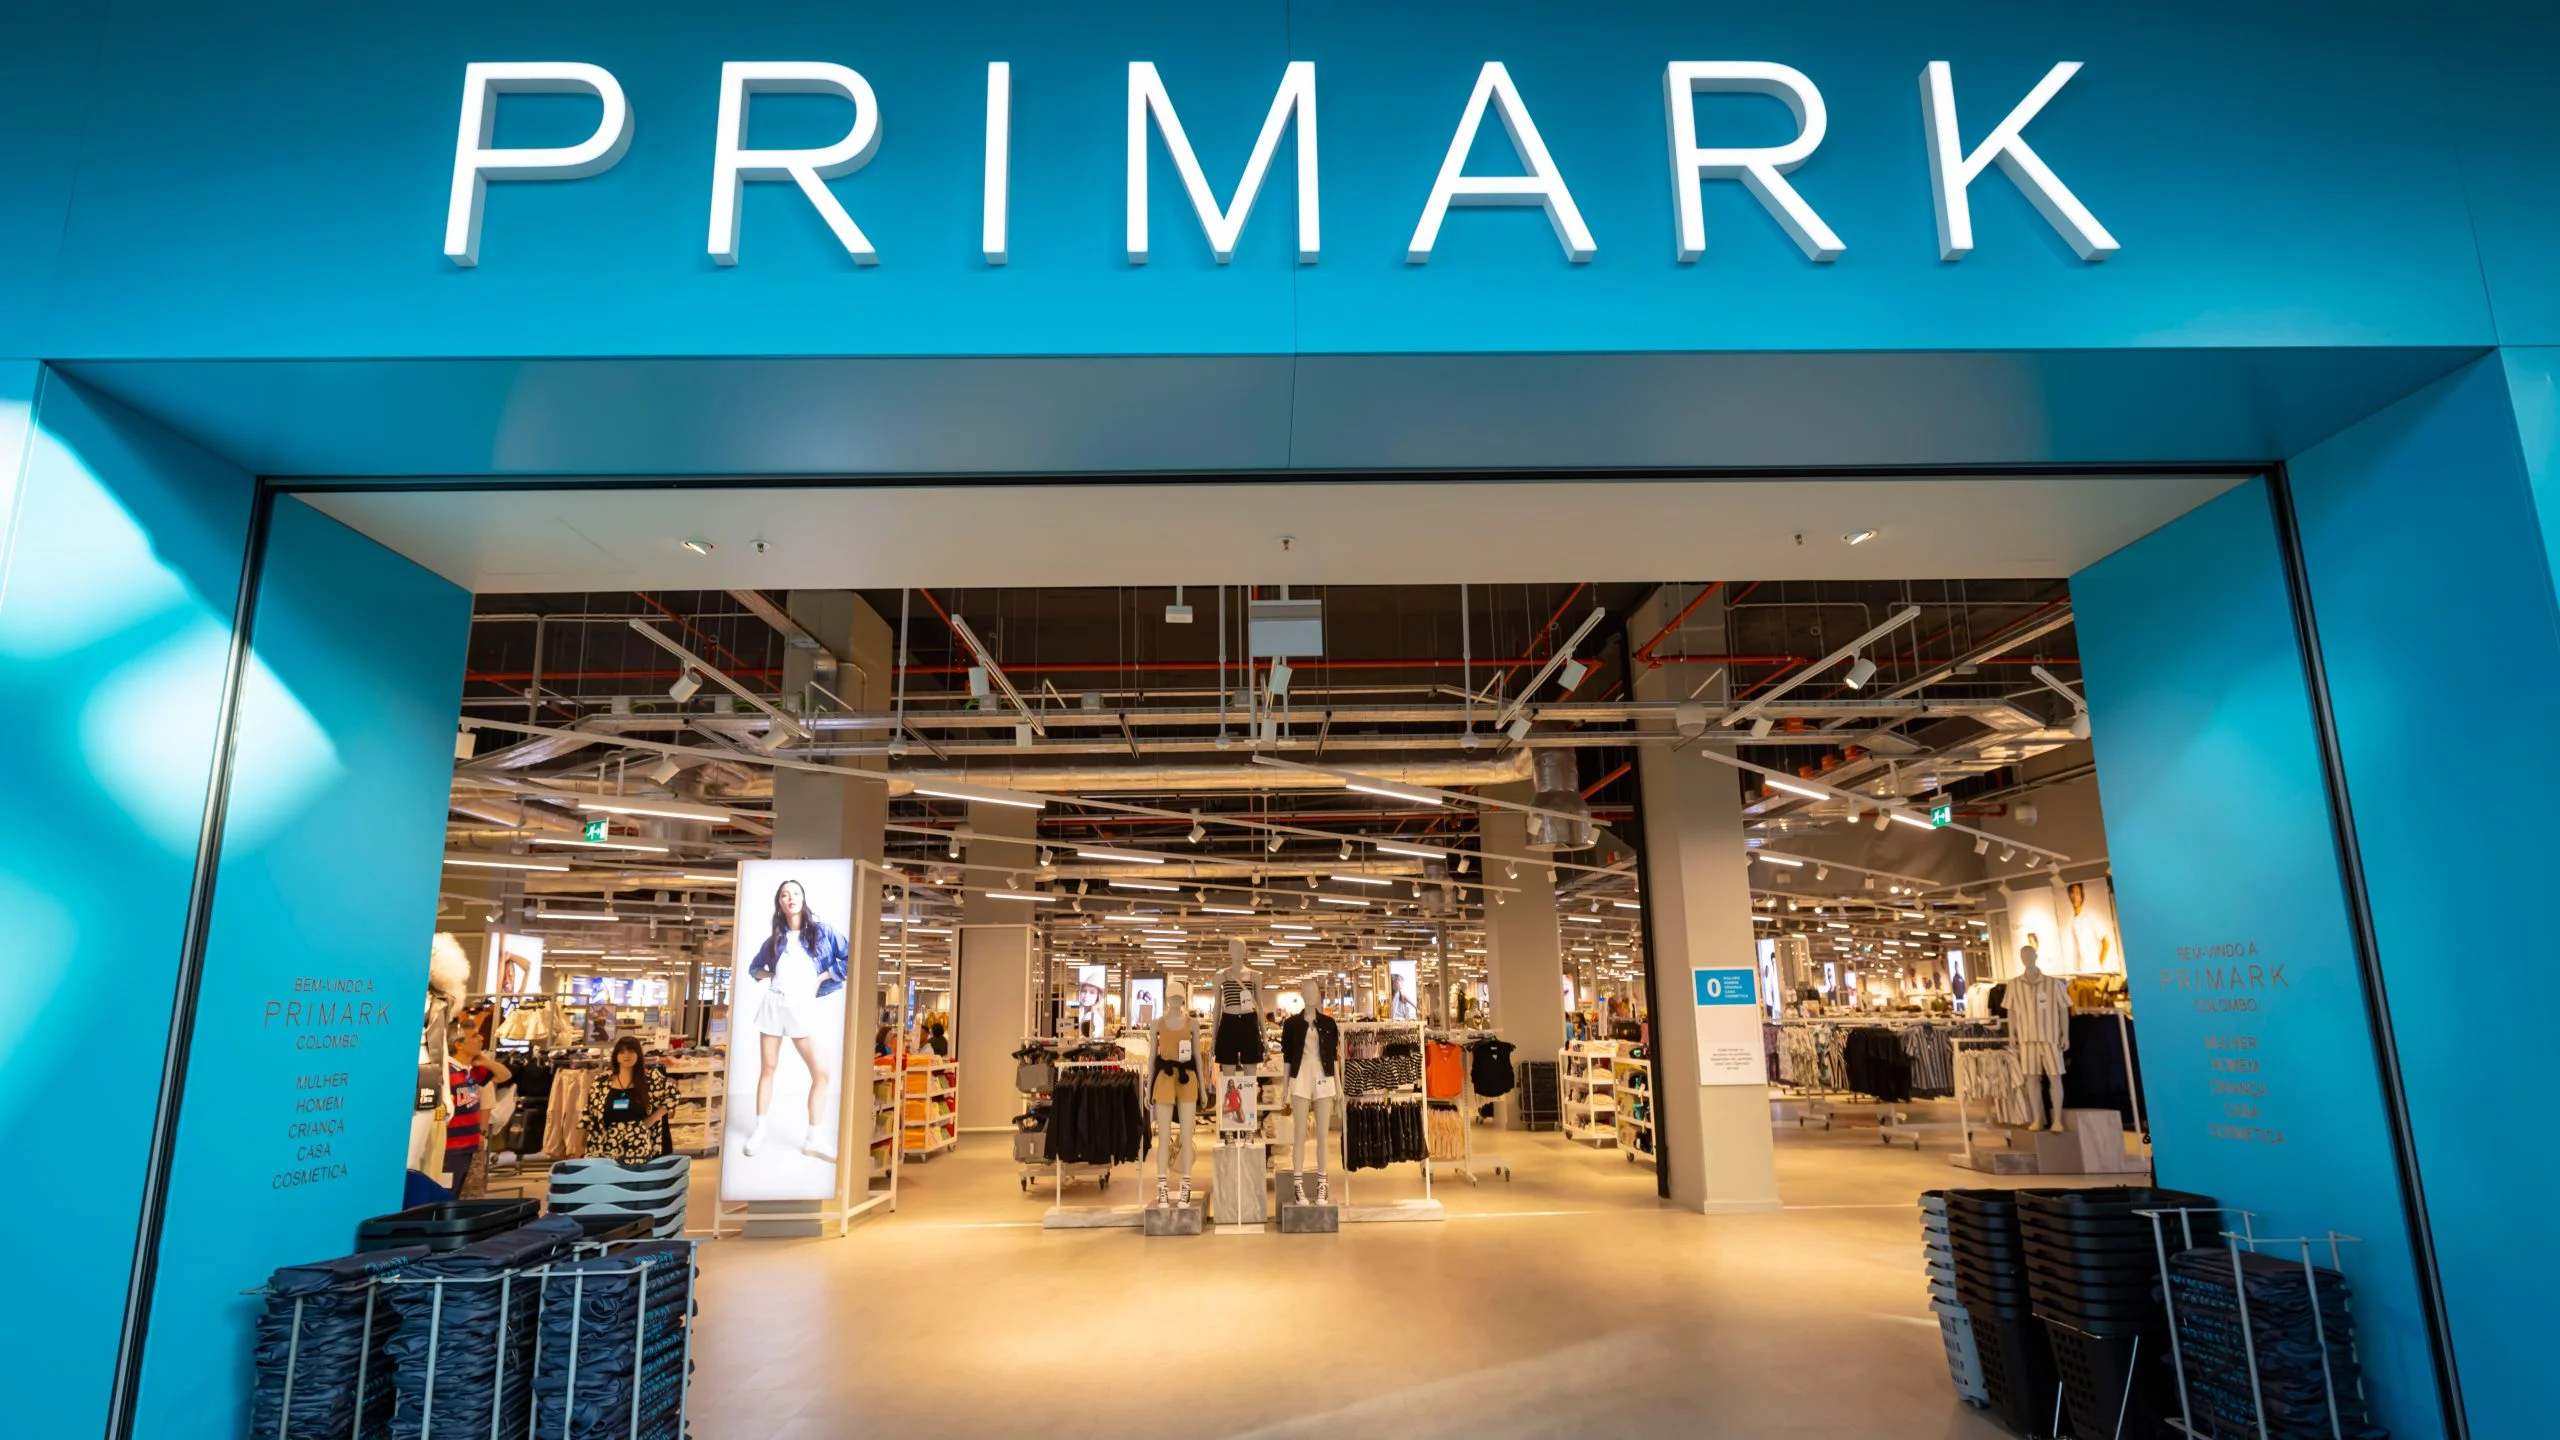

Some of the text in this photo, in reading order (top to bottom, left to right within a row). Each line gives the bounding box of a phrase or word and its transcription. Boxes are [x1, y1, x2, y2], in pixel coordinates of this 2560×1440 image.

[443, 60, 2122, 266] PRIMARK
[2176, 943, 2245, 961] BEM-VINDO
[294, 977, 363, 993] BEM-VINDO
[2160, 963, 2289, 992] PRIMARK
[1707, 978, 1721, 997] 0
[264, 1001, 392, 1027] PRIMARK
[2194, 998, 2258, 1012] COLOMBO
[296, 1034, 359, 1050] COLOMBO
[2205, 1035, 2257, 1050] MULHER
[2210, 1058, 2259, 1073] HOMEM
[296, 1072, 348, 1089] MULHER
[296, 1096, 344, 1114] HOMEM
[2224, 1102, 2260, 1118] CASA
[288, 1119, 344, 1139] CRIANÇA
[296, 1143, 331, 1162] CASA
